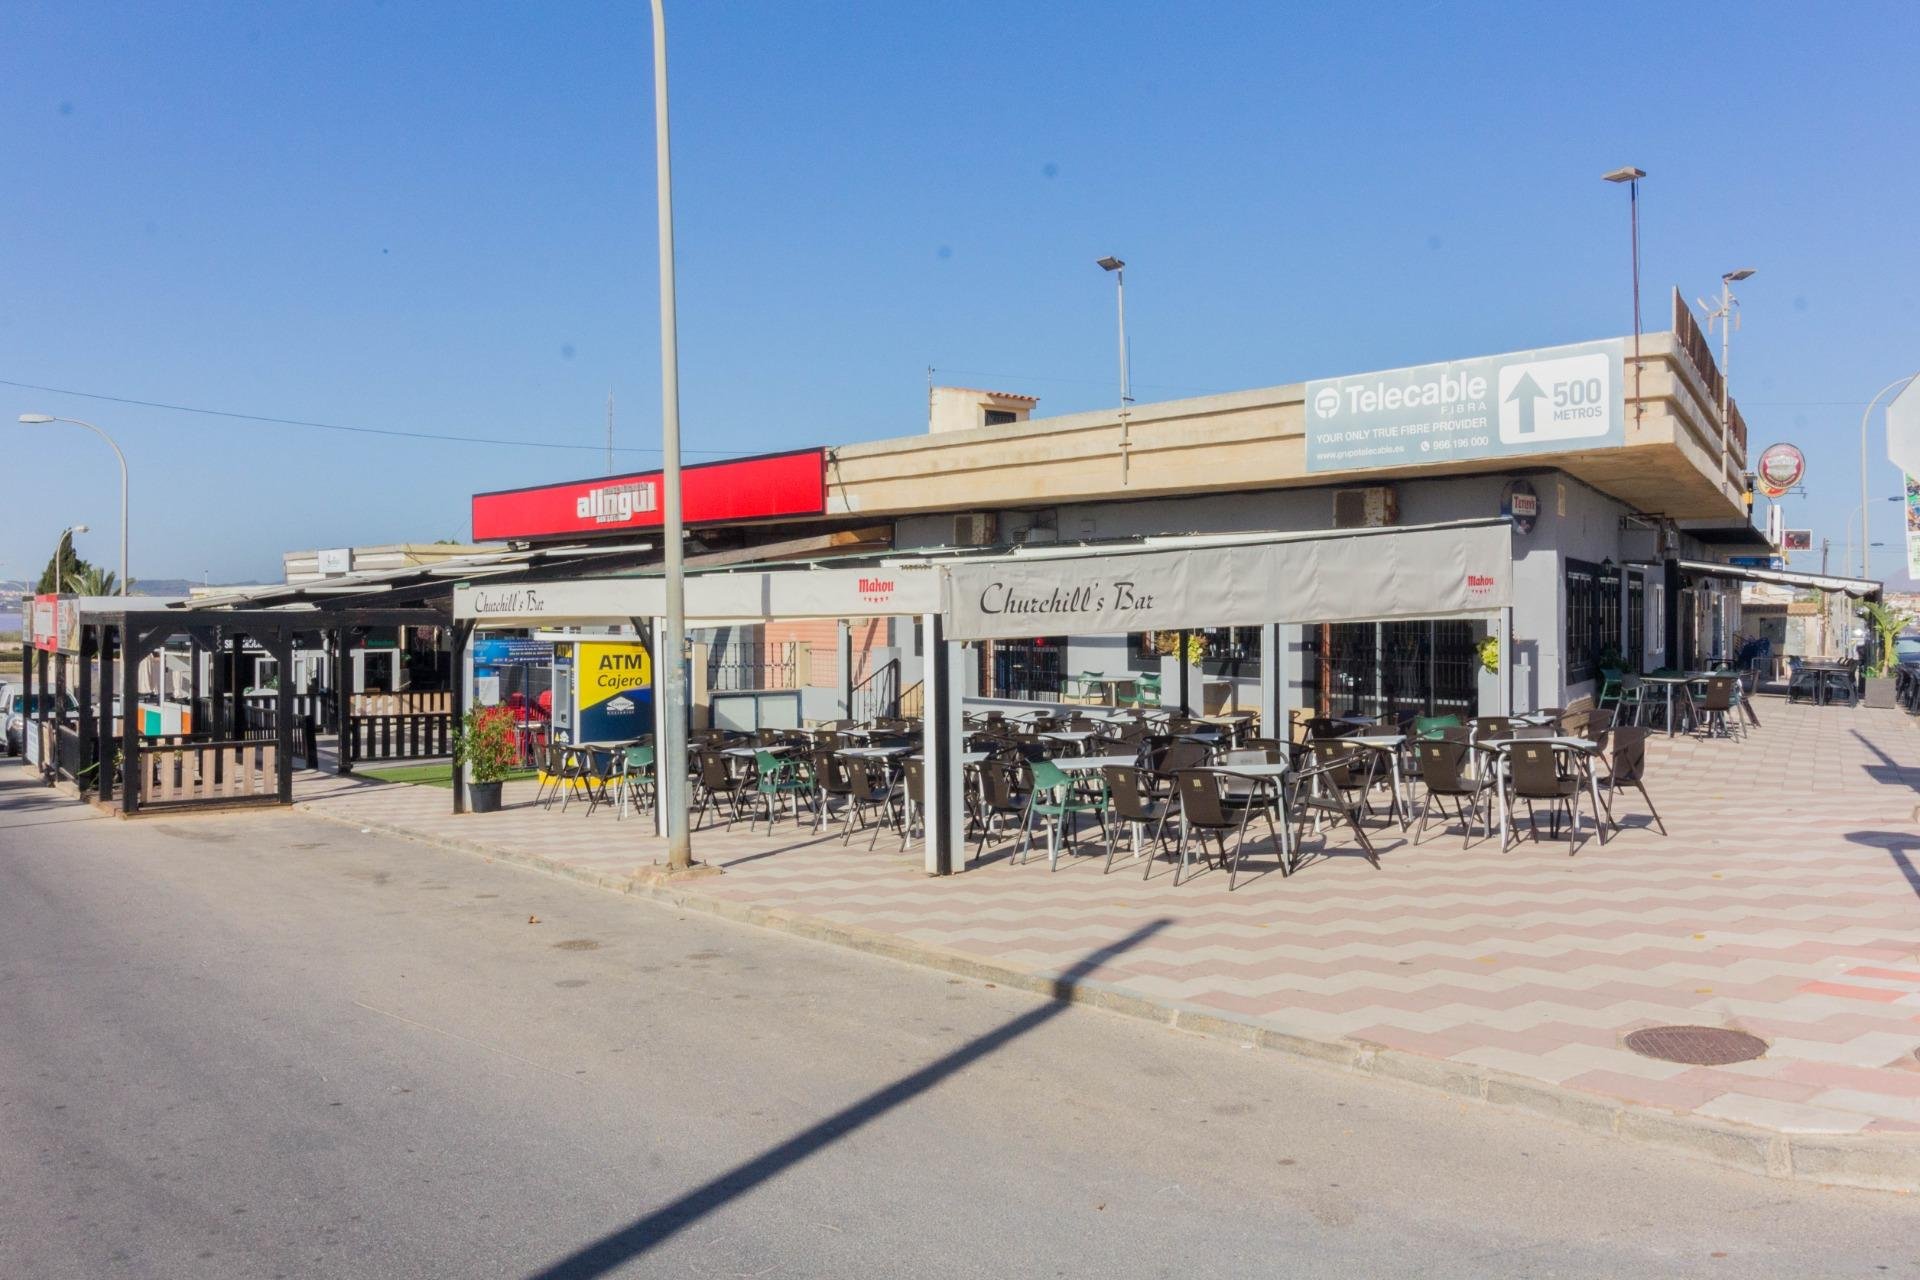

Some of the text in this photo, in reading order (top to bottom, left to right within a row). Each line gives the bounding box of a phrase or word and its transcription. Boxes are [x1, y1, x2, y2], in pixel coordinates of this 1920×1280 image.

[1345, 371, 1488, 415] Telecable
[1553, 378, 1602, 408] 500
[1440, 401, 1488, 415] FIBRA
[1553, 406, 1603, 422] METROS
[1316, 417, 1488, 444] YOUR ONLY TRUE FIBRE PROVIDER
[1471, 436, 1489, 447] 000
[858, 577, 894, 593] Mahou
[1468, 574, 1494, 587] Mahou
[474, 589, 545, 613] Churchill's Bar
[980, 581, 1155, 615] Churchill's Bar
[599, 653, 642, 671] ATM
[597, 674, 643, 690] Cajero
